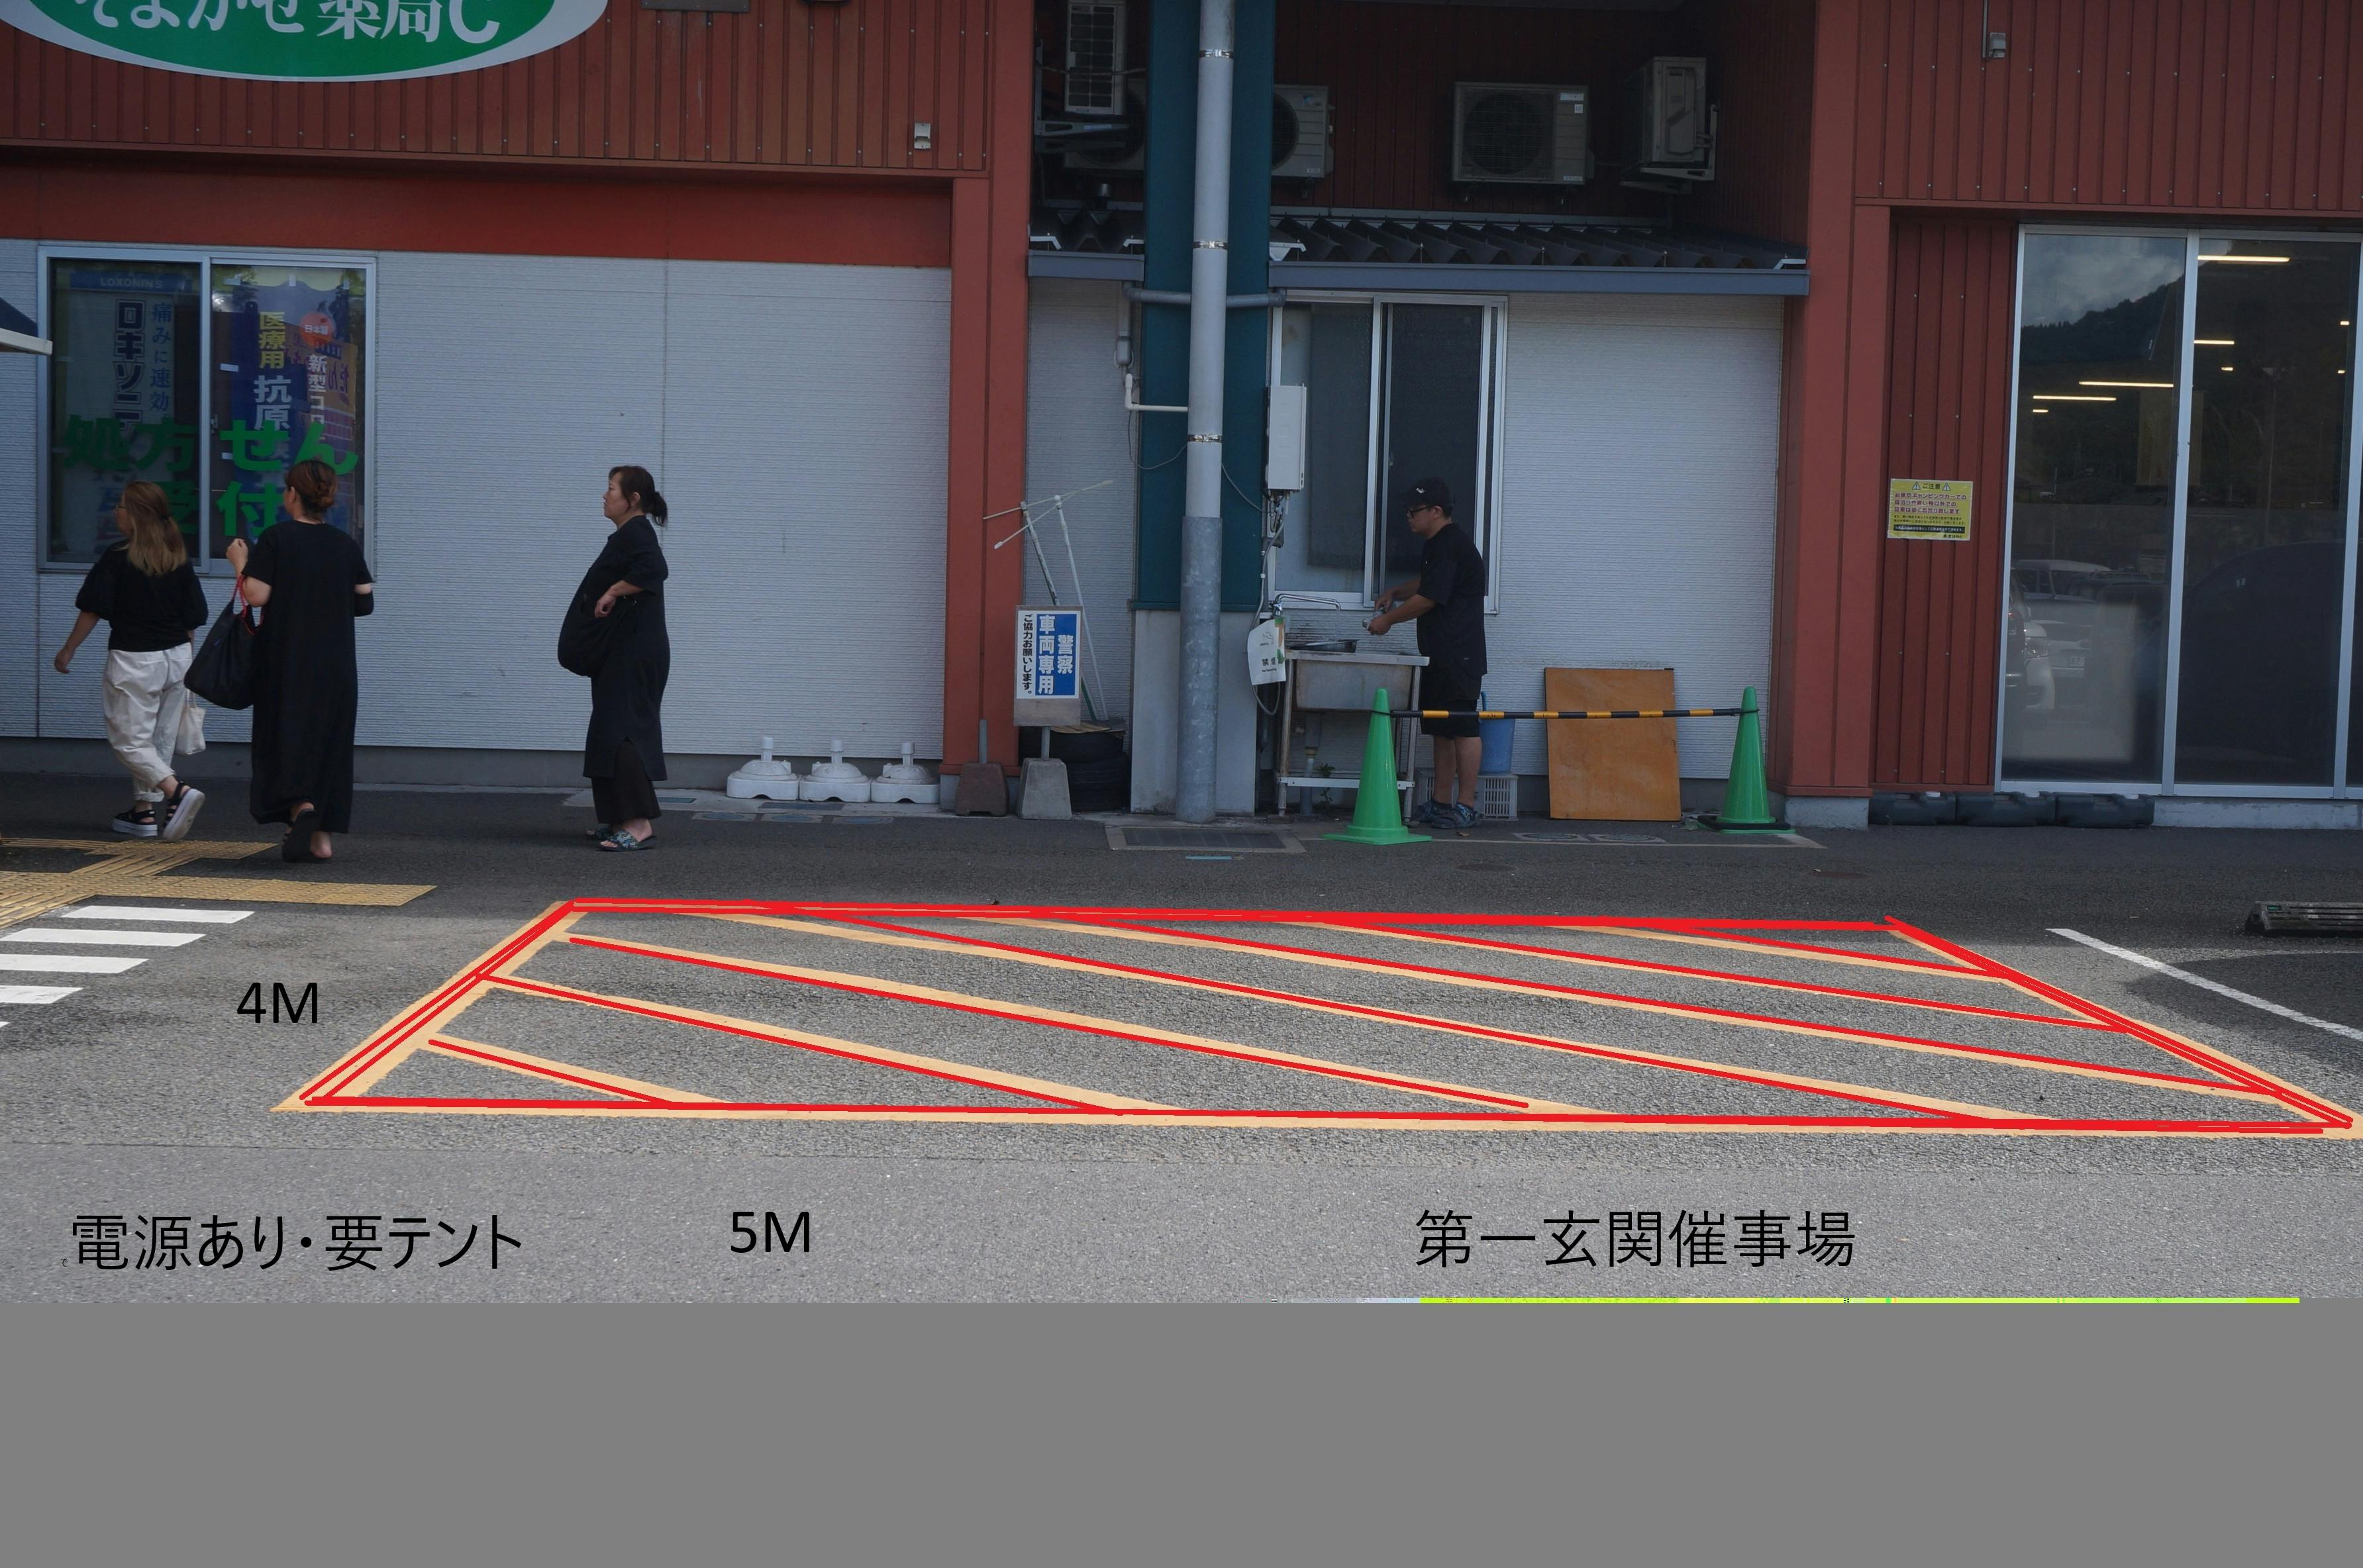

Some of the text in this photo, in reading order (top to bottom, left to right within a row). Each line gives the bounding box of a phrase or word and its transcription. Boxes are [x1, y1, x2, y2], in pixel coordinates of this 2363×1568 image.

[259, 311, 286, 369] 医療用
[307, 354, 327, 440] 新型コロ
[1023, 613, 1033, 694] ご協力お願いします。
[1038, 614, 1055, 695] 車両専用
[1058, 634, 1074, 674] 警察
